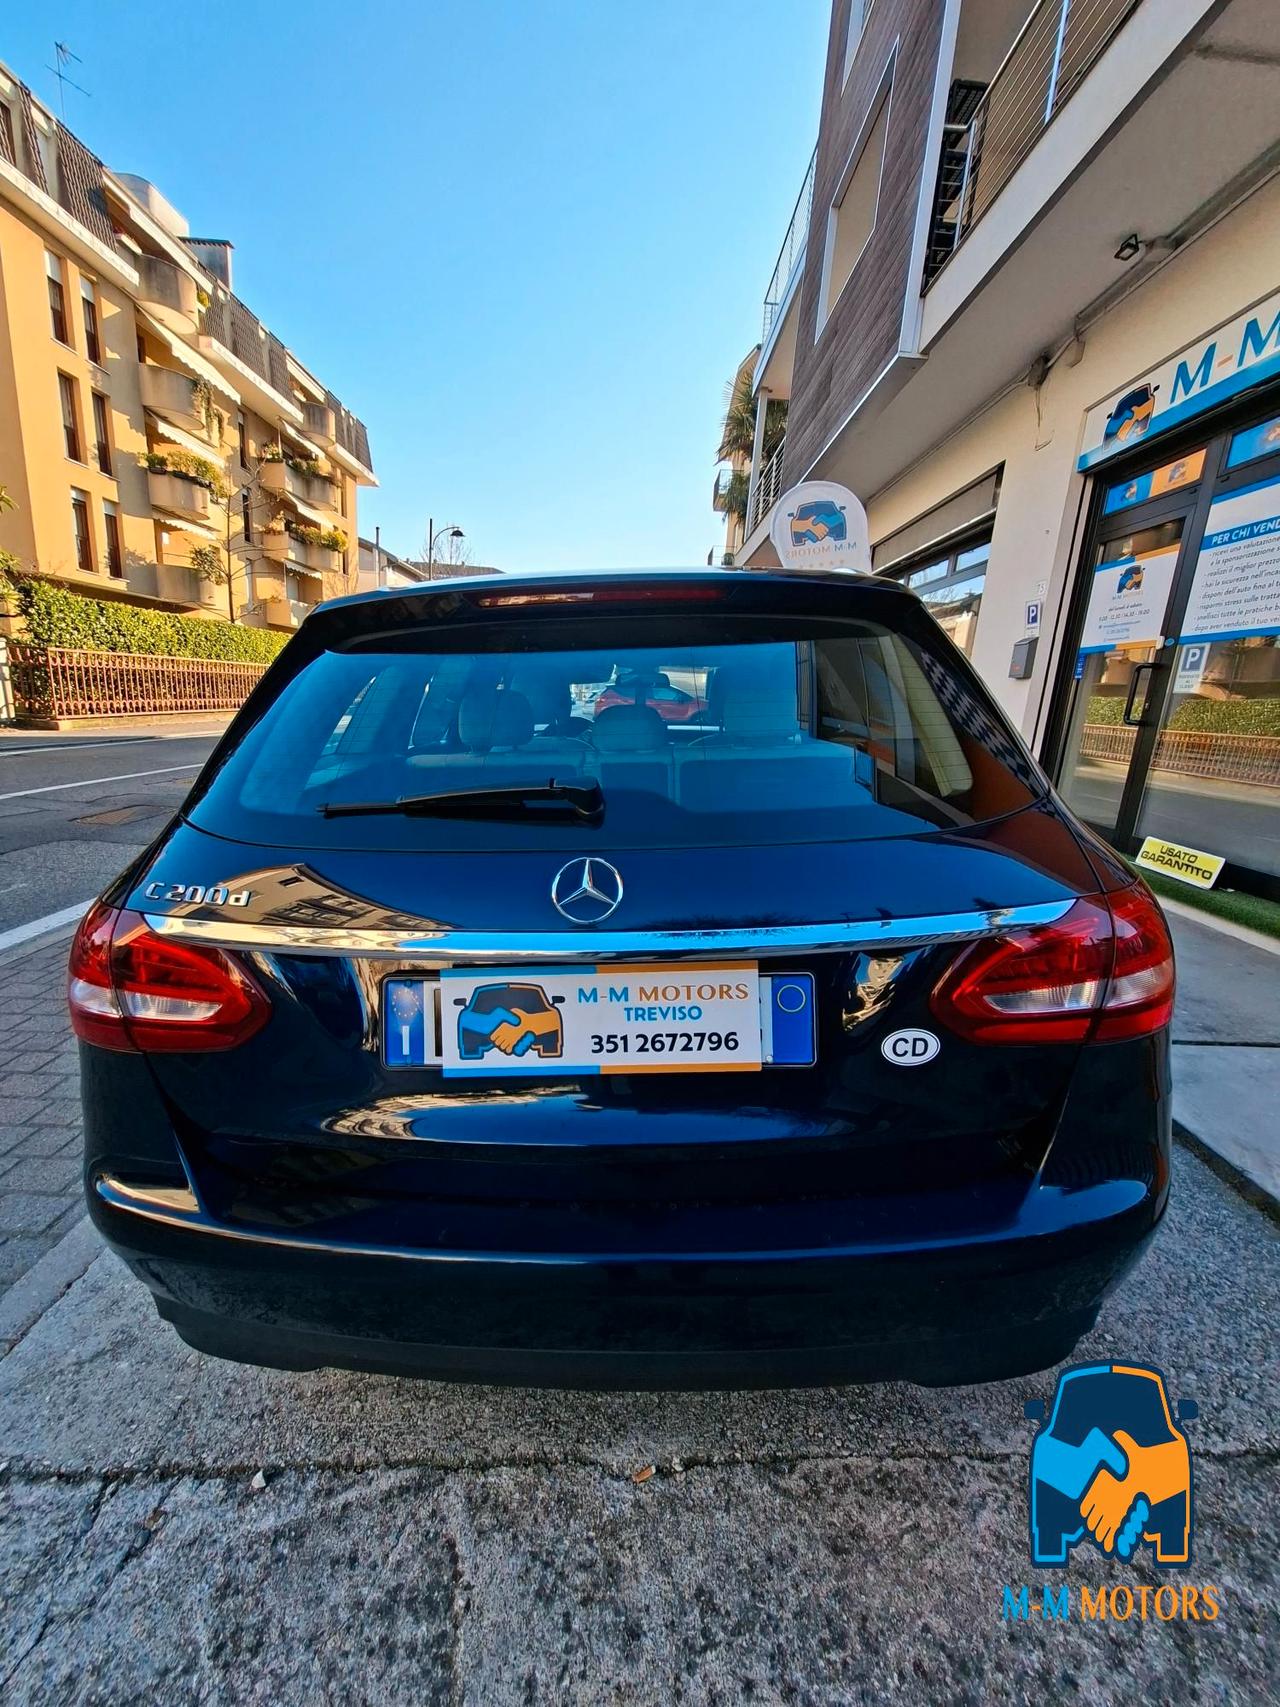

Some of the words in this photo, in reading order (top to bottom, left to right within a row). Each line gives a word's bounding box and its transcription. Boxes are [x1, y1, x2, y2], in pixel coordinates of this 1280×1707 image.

[1170, 309, 1280, 404] M-M
[1211, 532, 1230, 545] PER
[1231, 526, 1250, 540] CHI
[1030, 606, 1037, 623] P
[1186, 649, 1200, 669] P
[1160, 845, 1198, 864] USATO
[1141, 850, 1213, 880] GARANTITO
[578, 986, 629, 1003] M-M
[639, 983, 749, 1002] MOTORS
[624, 1006, 702, 1021] TREVISO
[892, 1037, 929, 1057] CD
